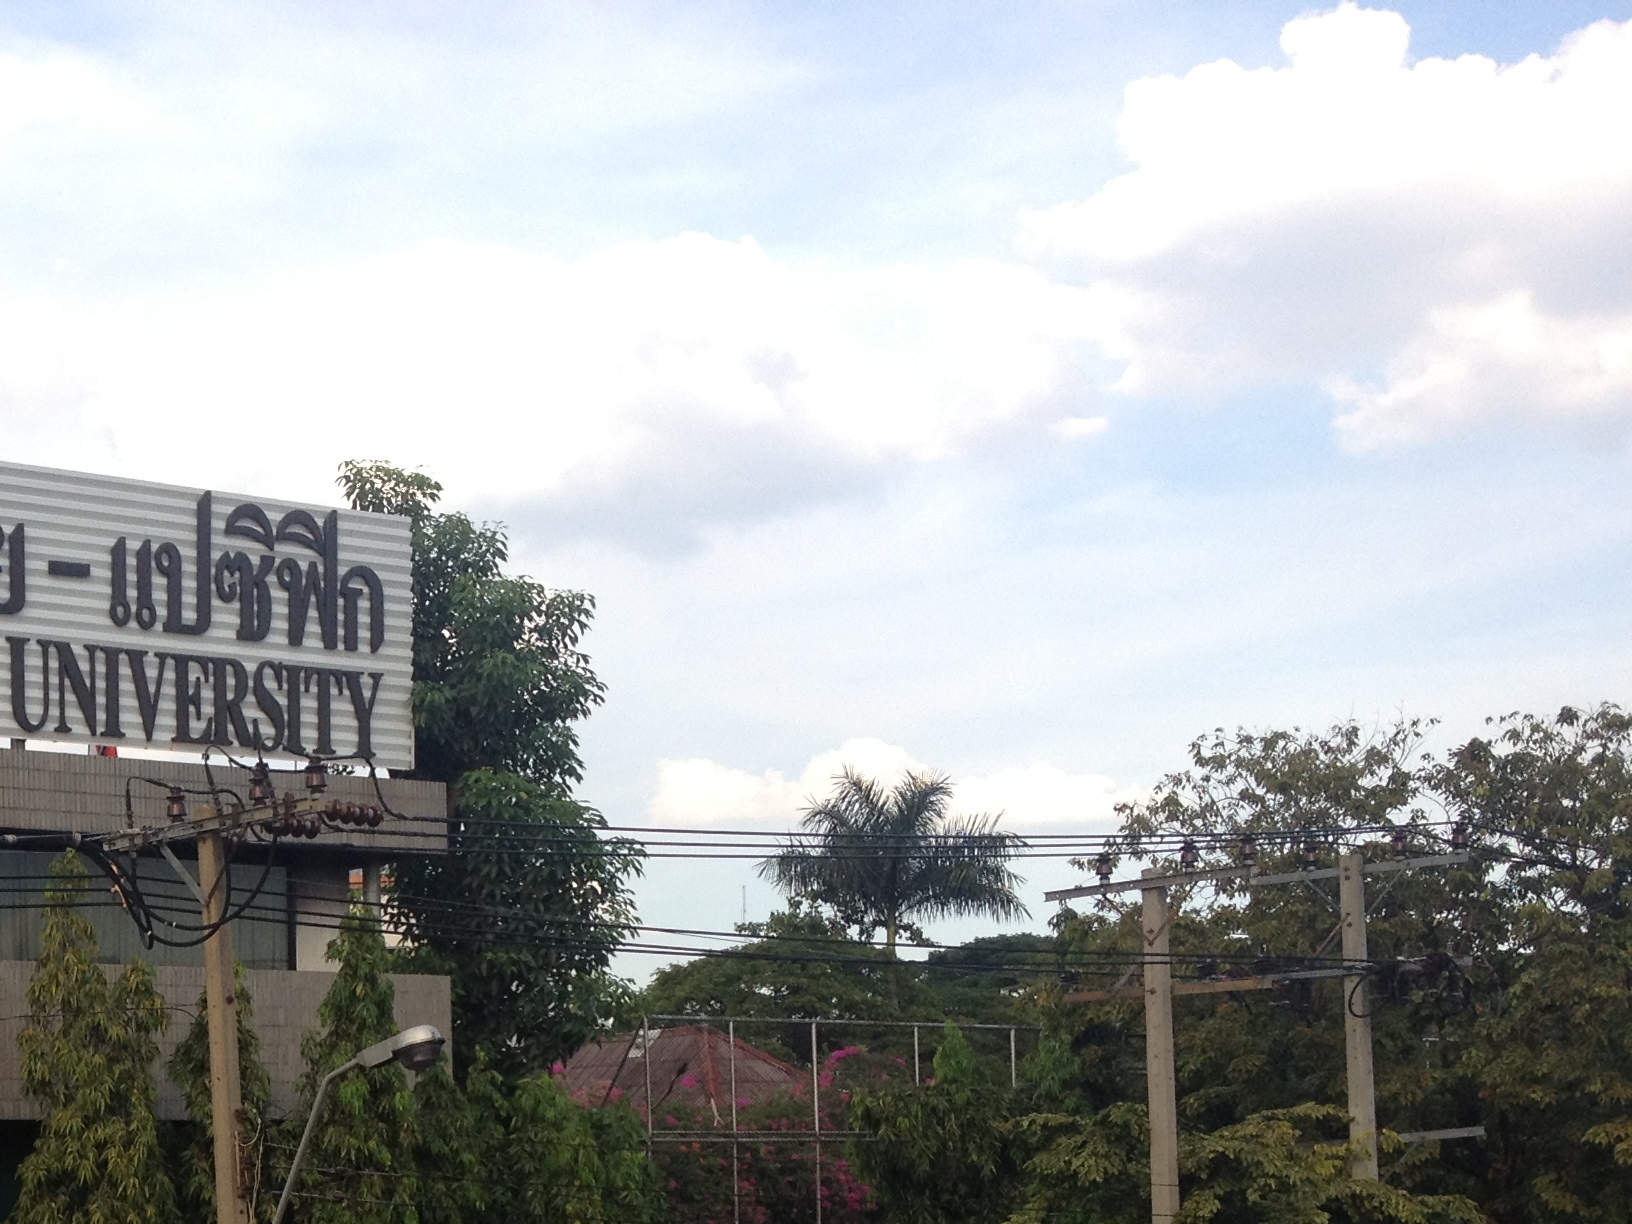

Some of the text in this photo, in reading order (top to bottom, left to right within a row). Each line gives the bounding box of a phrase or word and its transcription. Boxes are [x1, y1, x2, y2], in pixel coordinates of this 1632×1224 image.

[109, 490, 384, 654] แปซิฟิก
[5, 636, 384, 759] UNIVERSITY
